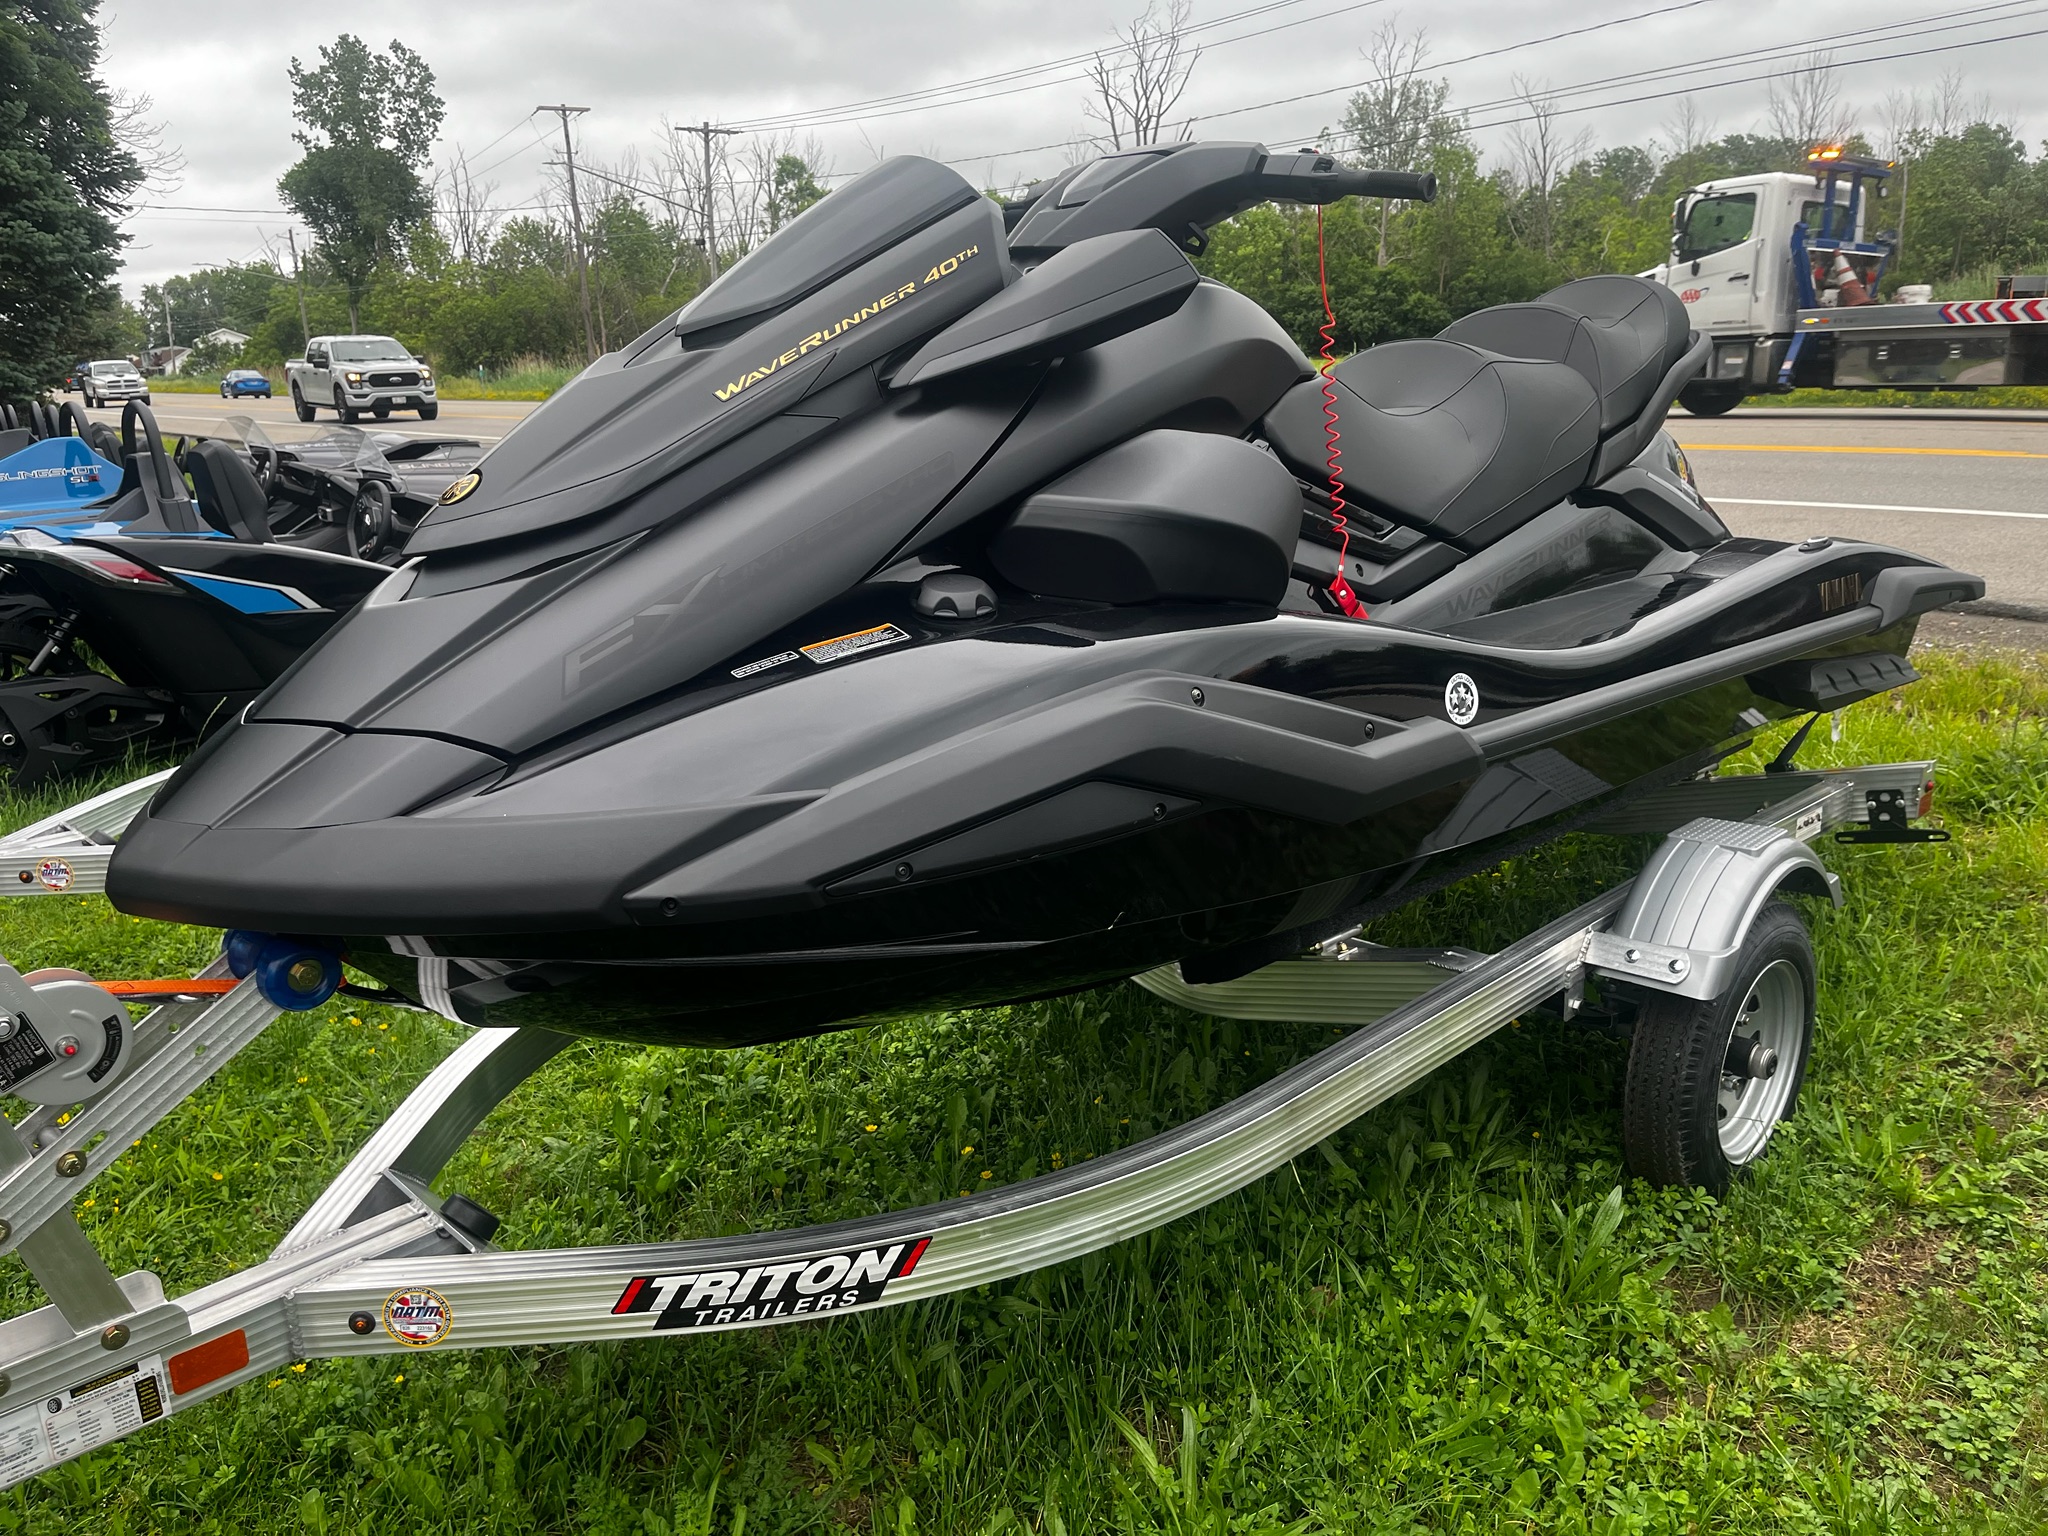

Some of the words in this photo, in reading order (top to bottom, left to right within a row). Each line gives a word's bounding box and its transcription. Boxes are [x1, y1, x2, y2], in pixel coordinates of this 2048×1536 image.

[922, 245, 980, 285] 40TH
[0, 465, 102, 482] SLINGSHOT
[562, 563, 728, 700] FX
[391, 1287, 428, 1301] COMPLIANCE
[429, 1291, 443, 1304] WITH
[650, 1243, 905, 1311] TRITON
[391, 1306, 441, 1318] NATM
[694, 1289, 859, 1326] TRAILERS
